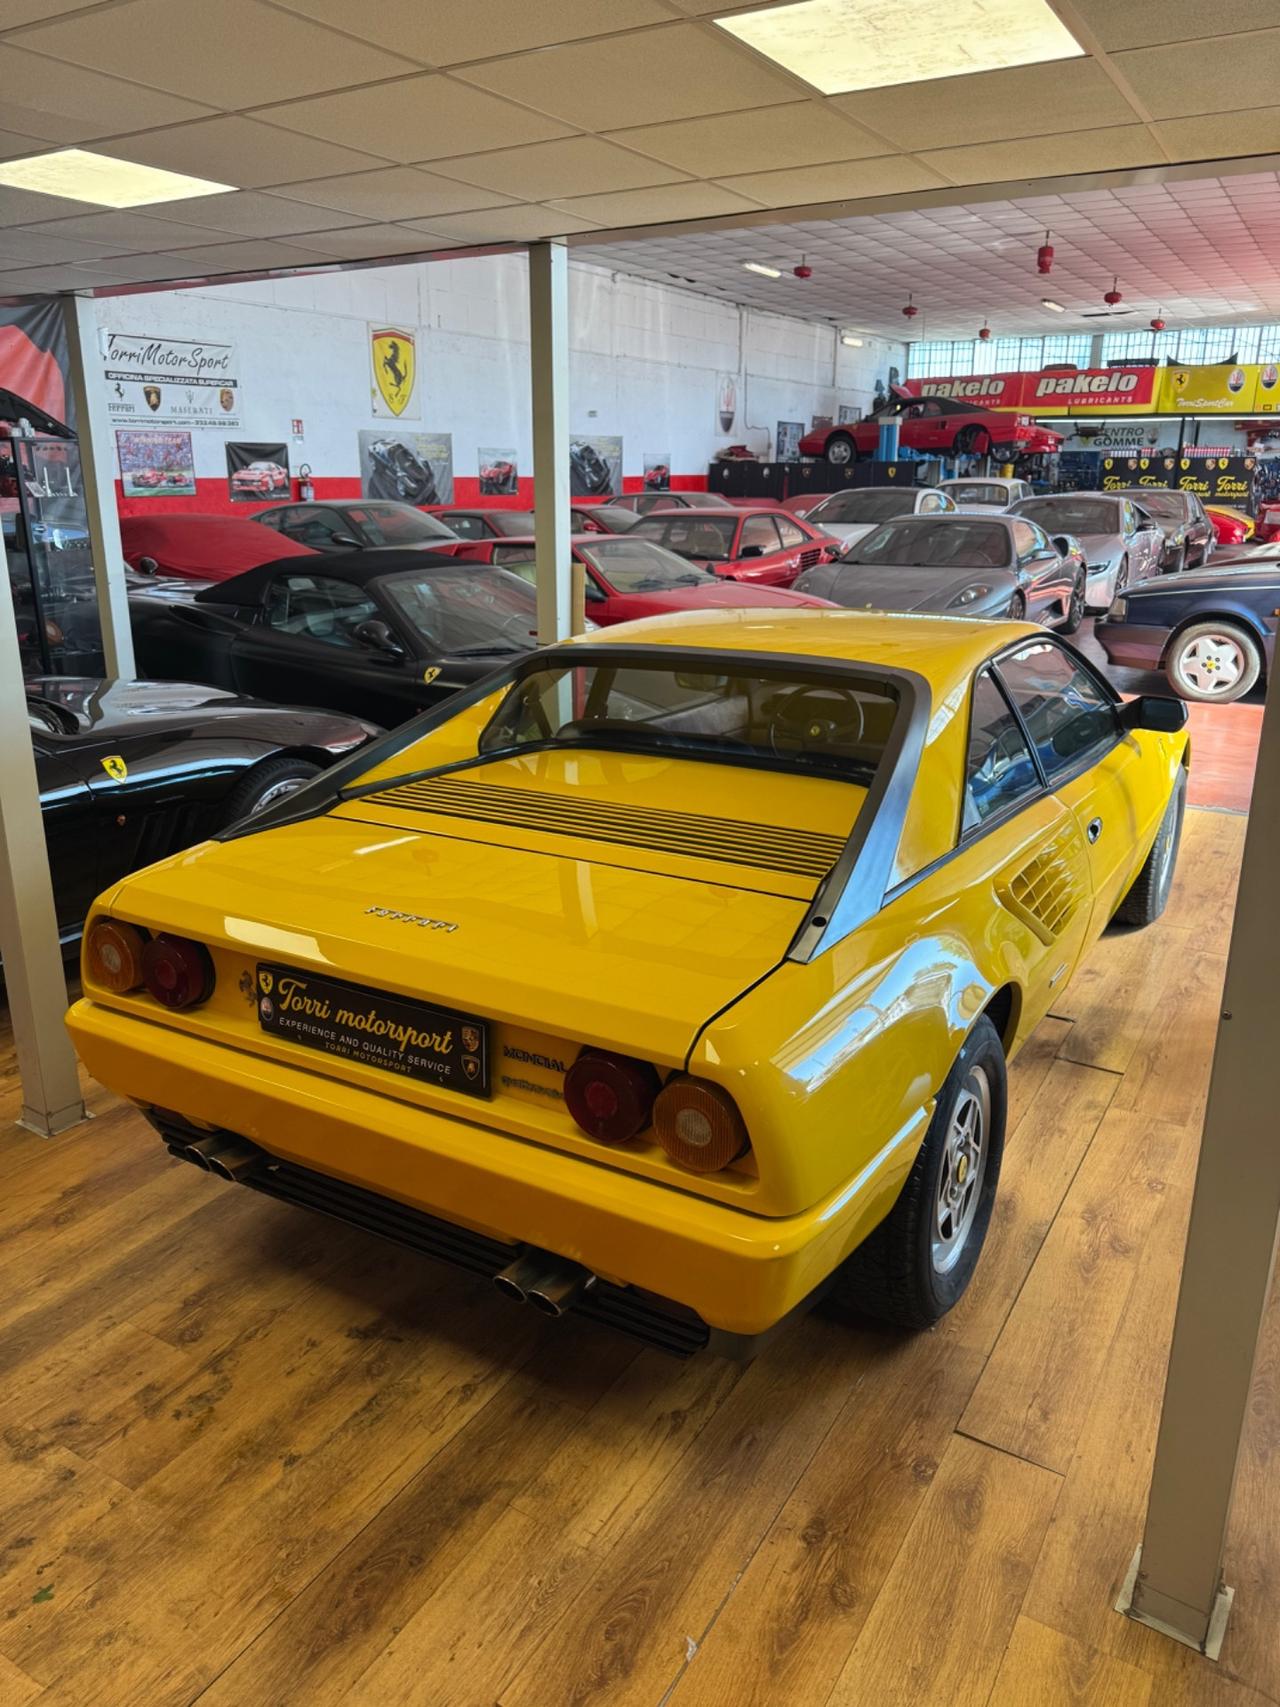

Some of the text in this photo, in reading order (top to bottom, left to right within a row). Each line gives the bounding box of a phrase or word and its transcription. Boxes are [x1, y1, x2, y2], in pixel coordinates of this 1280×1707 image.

[107, 372, 143, 381] OFFICINA
[144, 375, 197, 384] SPECIALIZZATA
[1036, 373, 1138, 397] pakelo
[107, 403, 135, 413] Ferrari
[1067, 396, 1132, 404] LUBRICANTS
[170, 406, 213, 415] MASERATI
[1101, 427, 1145, 437] ENTRO
[1093, 437, 1144, 446] GOMME
[1179, 475, 1209, 491] Torri
[1217, 475, 1248, 492] Torri
[364, 904, 459, 933] Ferrari
[278, 978, 454, 1055] Torri motorsport
[279, 1017, 452, 1075] EXPERIENCE AND QUALITY SERVICE
[325, 1041, 412, 1073] TORRI MOTORSPORT
